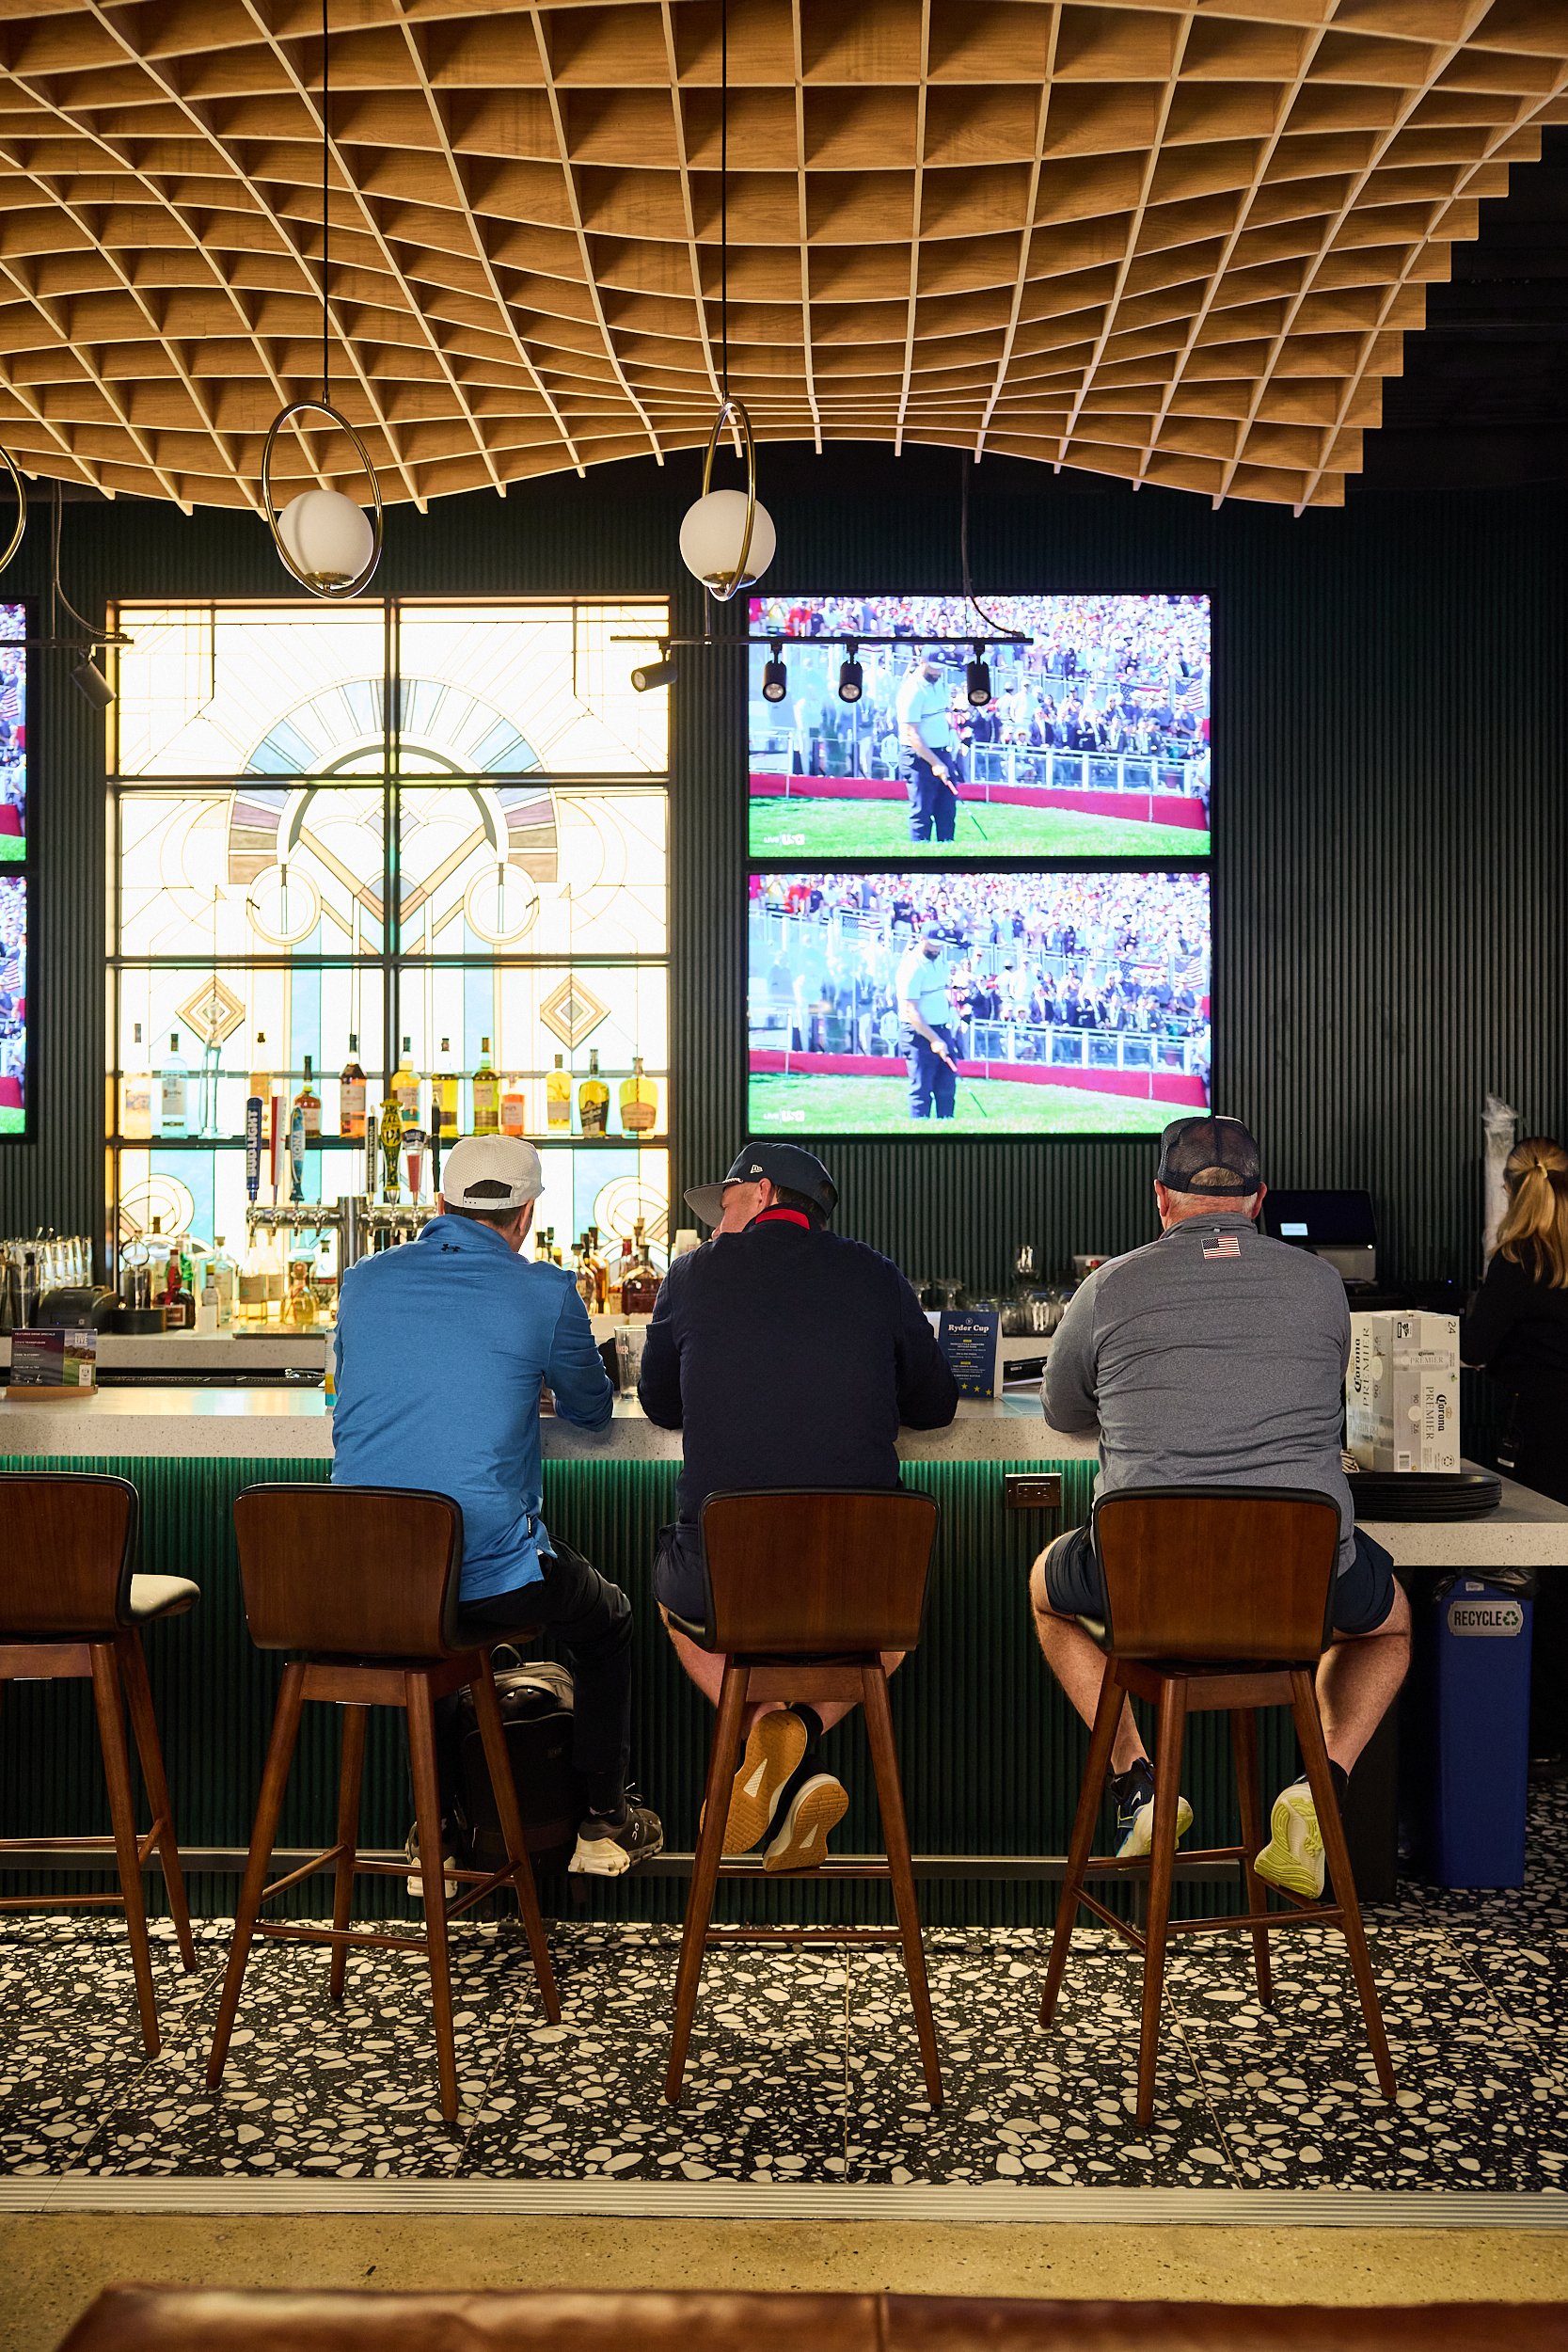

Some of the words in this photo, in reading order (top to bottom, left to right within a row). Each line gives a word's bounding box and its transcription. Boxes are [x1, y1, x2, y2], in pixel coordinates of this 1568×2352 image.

[247, 1109, 258, 1148] LIGHT
[293, 1131, 303, 1161] KONA
[246, 1149, 257, 1177] BUD
[973, 1325, 990, 1333] Cup
[1448, 1321, 1456, 1334] 24
[1354, 1338, 1362, 1393] Corona
[1413, 1394, 1418, 1404] 90
[1426, 1386, 1434, 1440] PREMIER
[1435, 1393, 1447, 1432] Corona
[1454, 1611, 1502, 1626] RECYCLE
